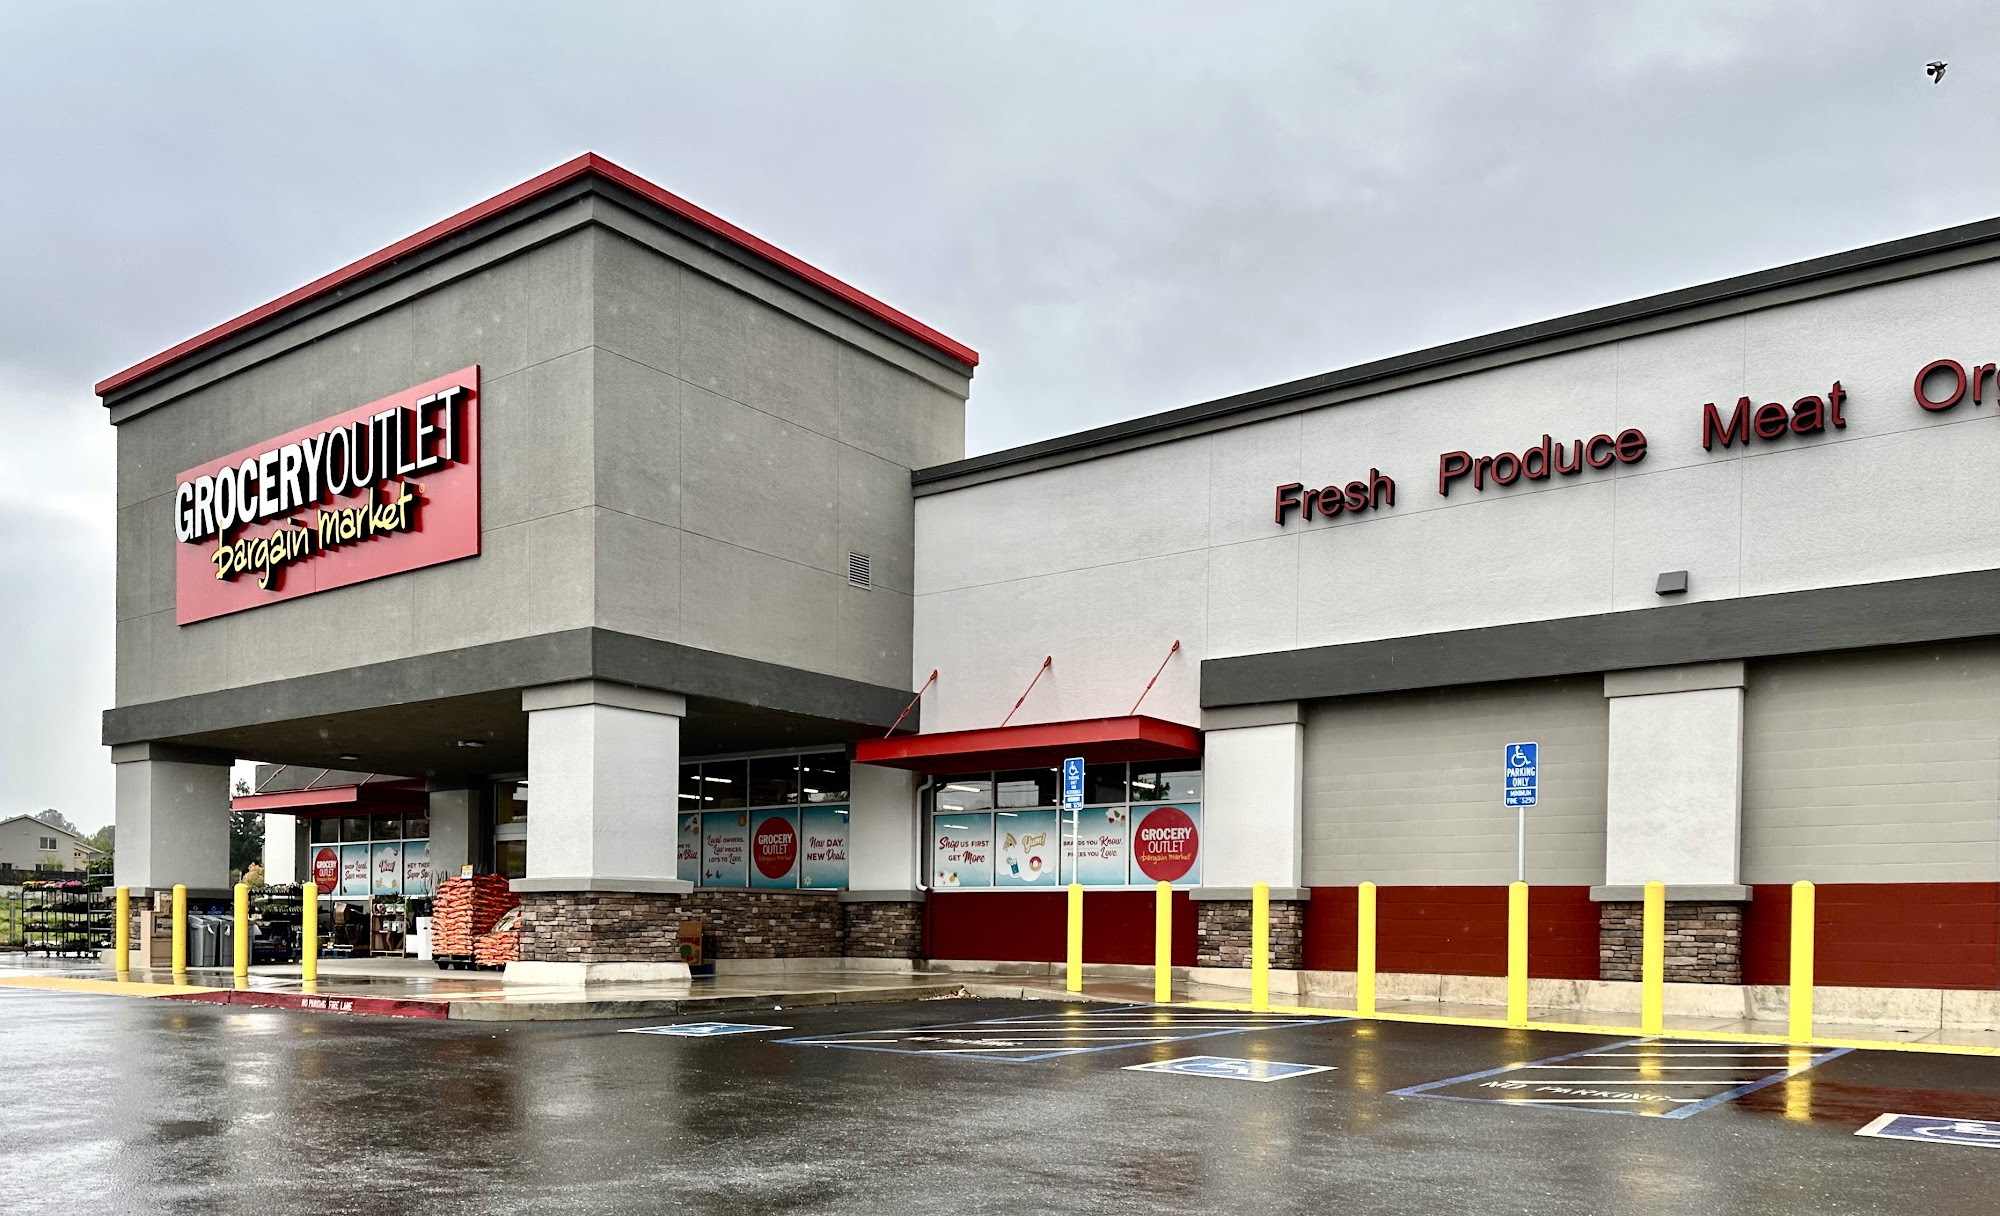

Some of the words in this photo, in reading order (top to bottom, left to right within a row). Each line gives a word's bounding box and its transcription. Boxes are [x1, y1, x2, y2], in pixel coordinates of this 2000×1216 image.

[1275, 467, 1395, 526] Fresh
[1439, 428, 1648, 497] Produce
[1702, 380, 1847, 450] Meat
[1914, 359, 2000, 412] Or
[211, 517, 309, 590] bargain
[317, 481, 413, 549] market
[1507, 767, 1536, 777] PARKING
[1512, 777, 1530, 787] ONLY
[758, 833, 793, 845] GROCERY
[1141, 827, 1192, 841] GROCERY
[827, 838, 844, 847] DAY.
[939, 836, 960, 852] Shop
[1148, 840, 1184, 854] OUTLET
[762, 844, 788, 855] OUTLET
[807, 853, 825, 861] NEW
[948, 854, 961, 862] GET
[962, 850, 986, 865] More
[1141, 851, 1168, 864] bargain
[1168, 852, 1192, 861] market
[301, 999, 309, 1007] NO
[328, 1000, 340, 1010] FIRE
[340, 1001, 353, 1011] LANE
[1535, 1086, 1673, 1100] PARKING
